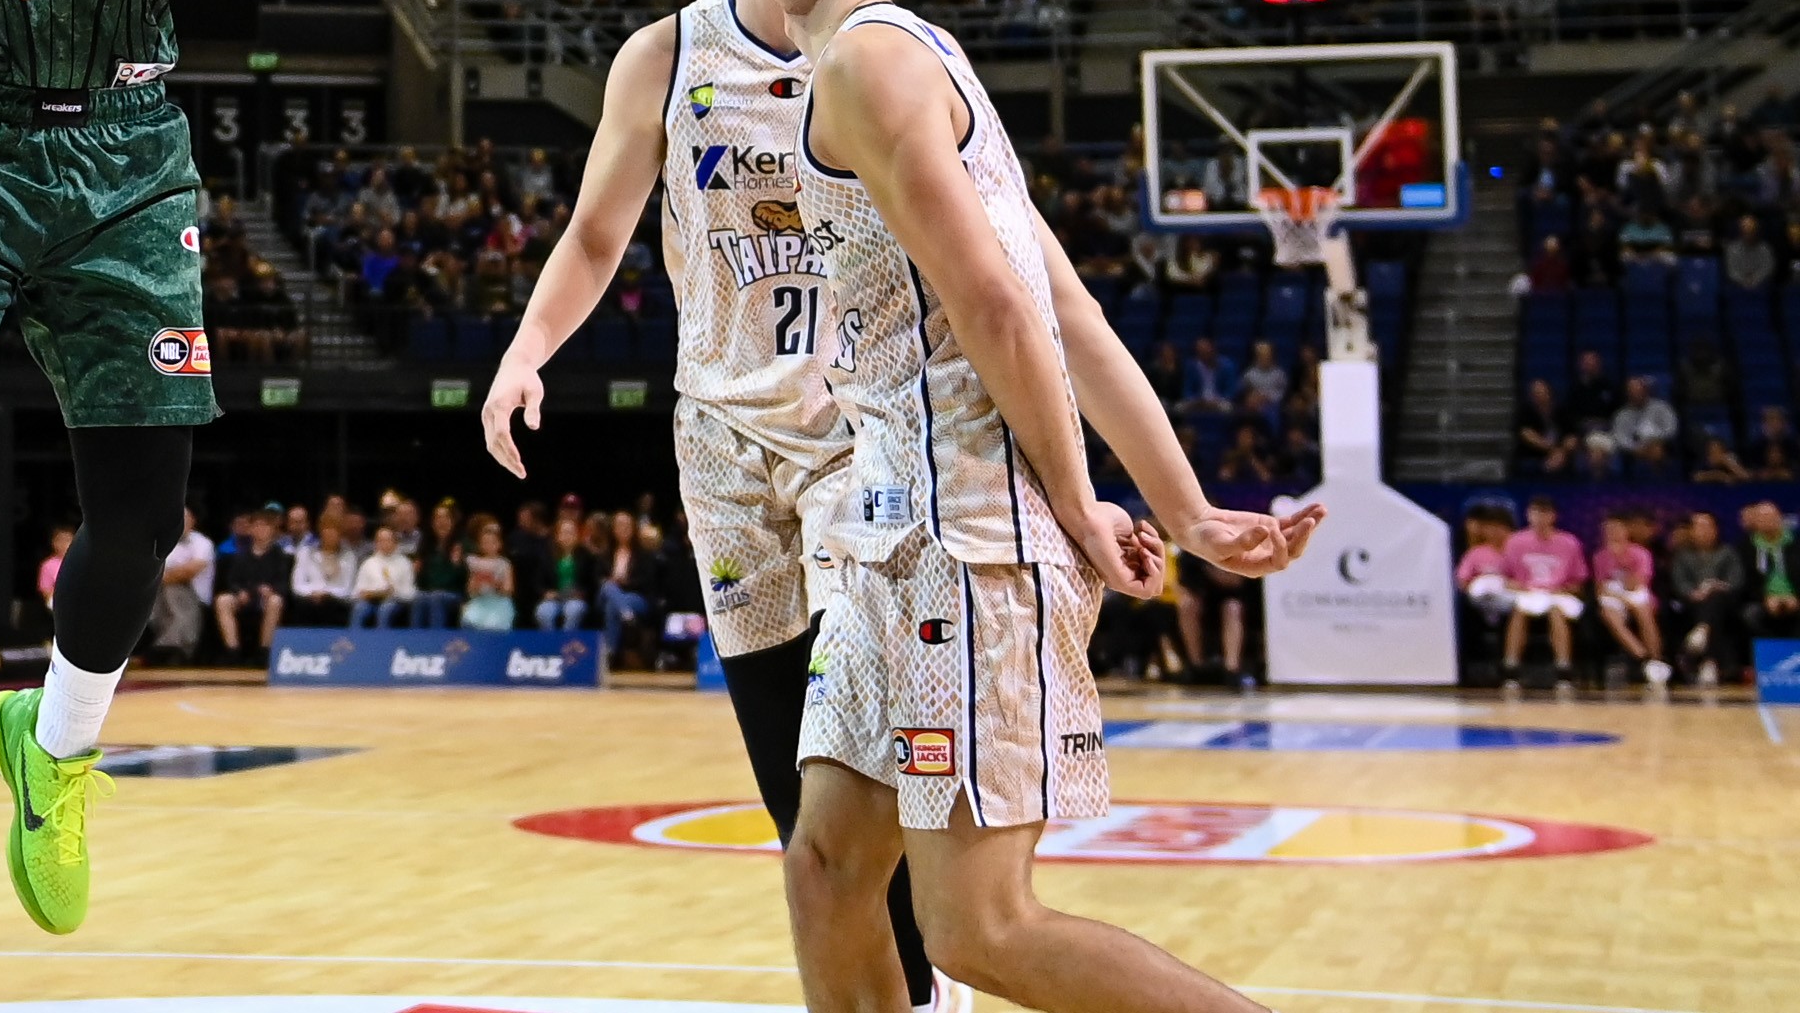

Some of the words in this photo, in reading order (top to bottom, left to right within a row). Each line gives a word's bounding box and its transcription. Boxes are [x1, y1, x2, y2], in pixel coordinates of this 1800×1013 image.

[215, 107, 239, 142] 3
[341, 109, 366, 143] 3
[734, 175, 794, 190] Homes
[708, 229, 828, 290] TAIPA
[773, 287, 818, 356] 21
[160, 342, 181, 360] NBL
[276, 648, 332, 677] bnz
[391, 648, 447, 678] bnz
[507, 648, 564, 679] bnz
[916, 752, 948, 763] JACK'S
[1060, 732, 1103, 755] TRIN
